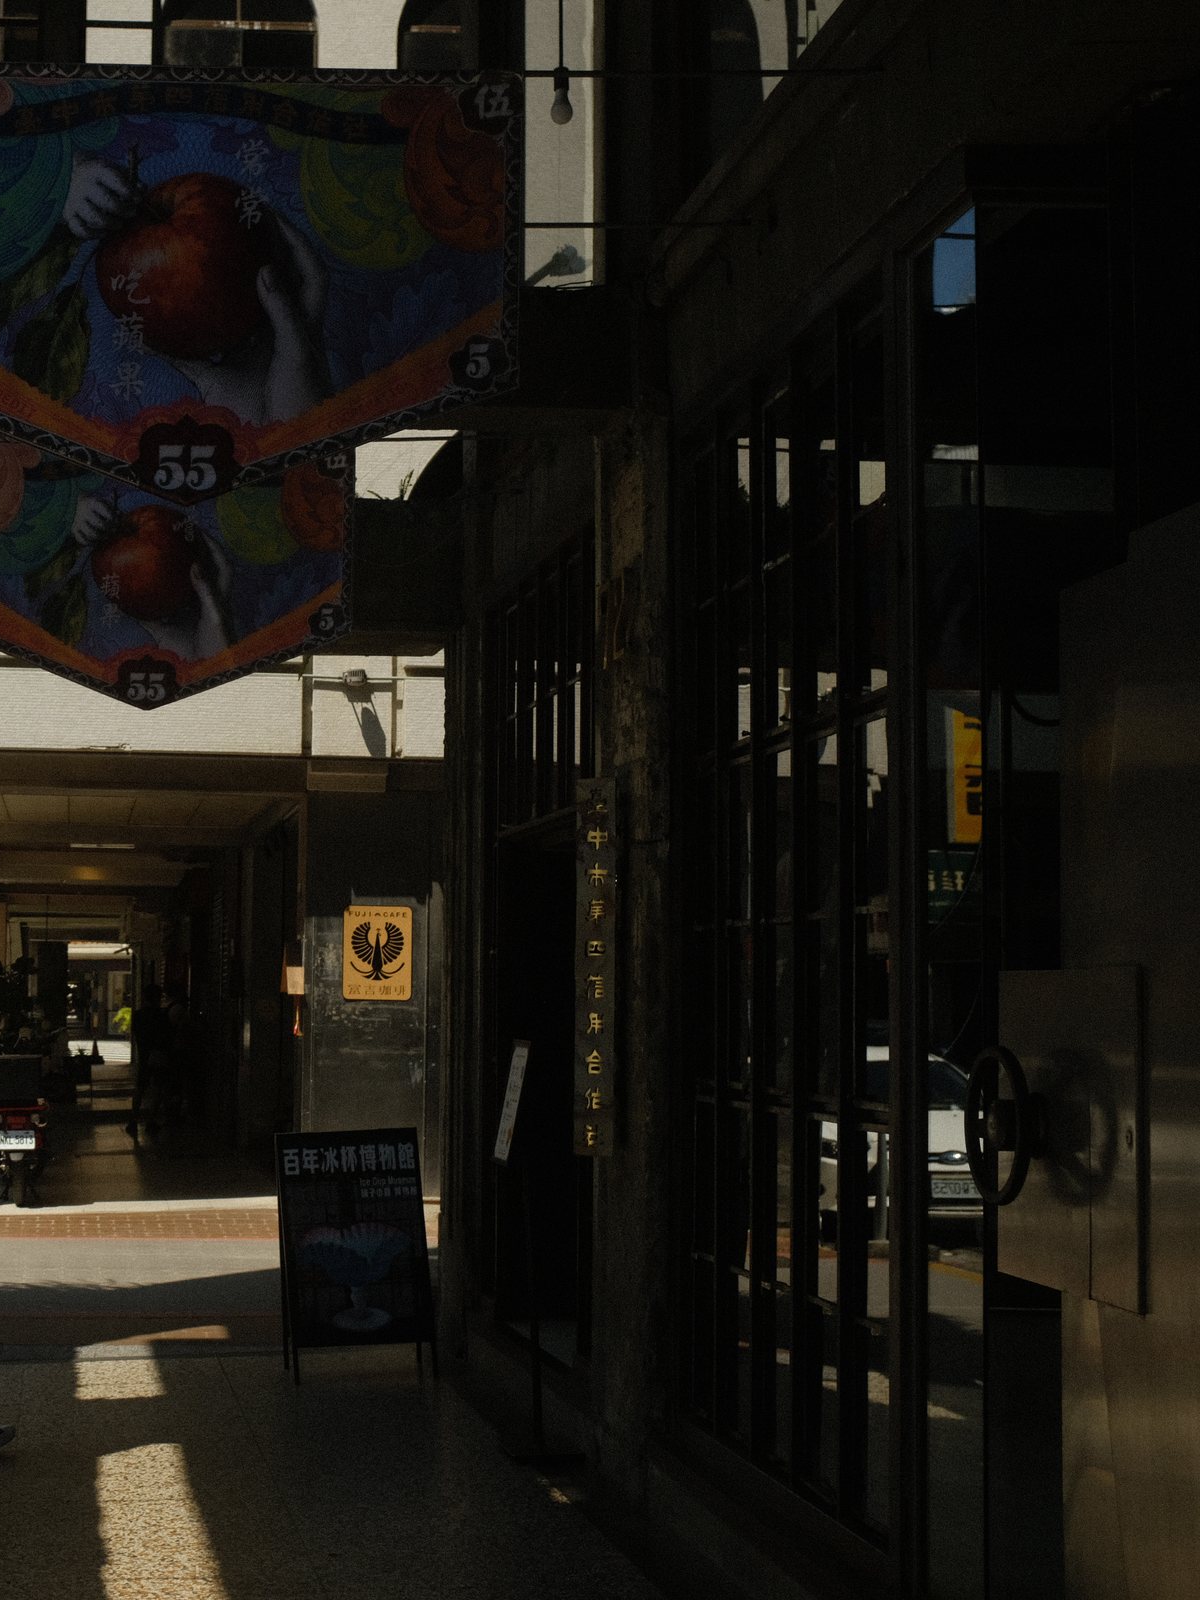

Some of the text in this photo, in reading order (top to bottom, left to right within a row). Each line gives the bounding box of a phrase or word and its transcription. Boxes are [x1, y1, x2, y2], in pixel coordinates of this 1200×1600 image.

[473, 83, 511, 118] 伍
[233, 137, 268, 230] 常常
[467, 344, 492, 379] 5
[153, 443, 218, 491] 55
[320, 608, 334, 631] 5
[126, 672, 166, 702] 55
[348, 910, 372, 918] FUJI
[282, 1141, 417, 1176] 百年冰杯博物館
